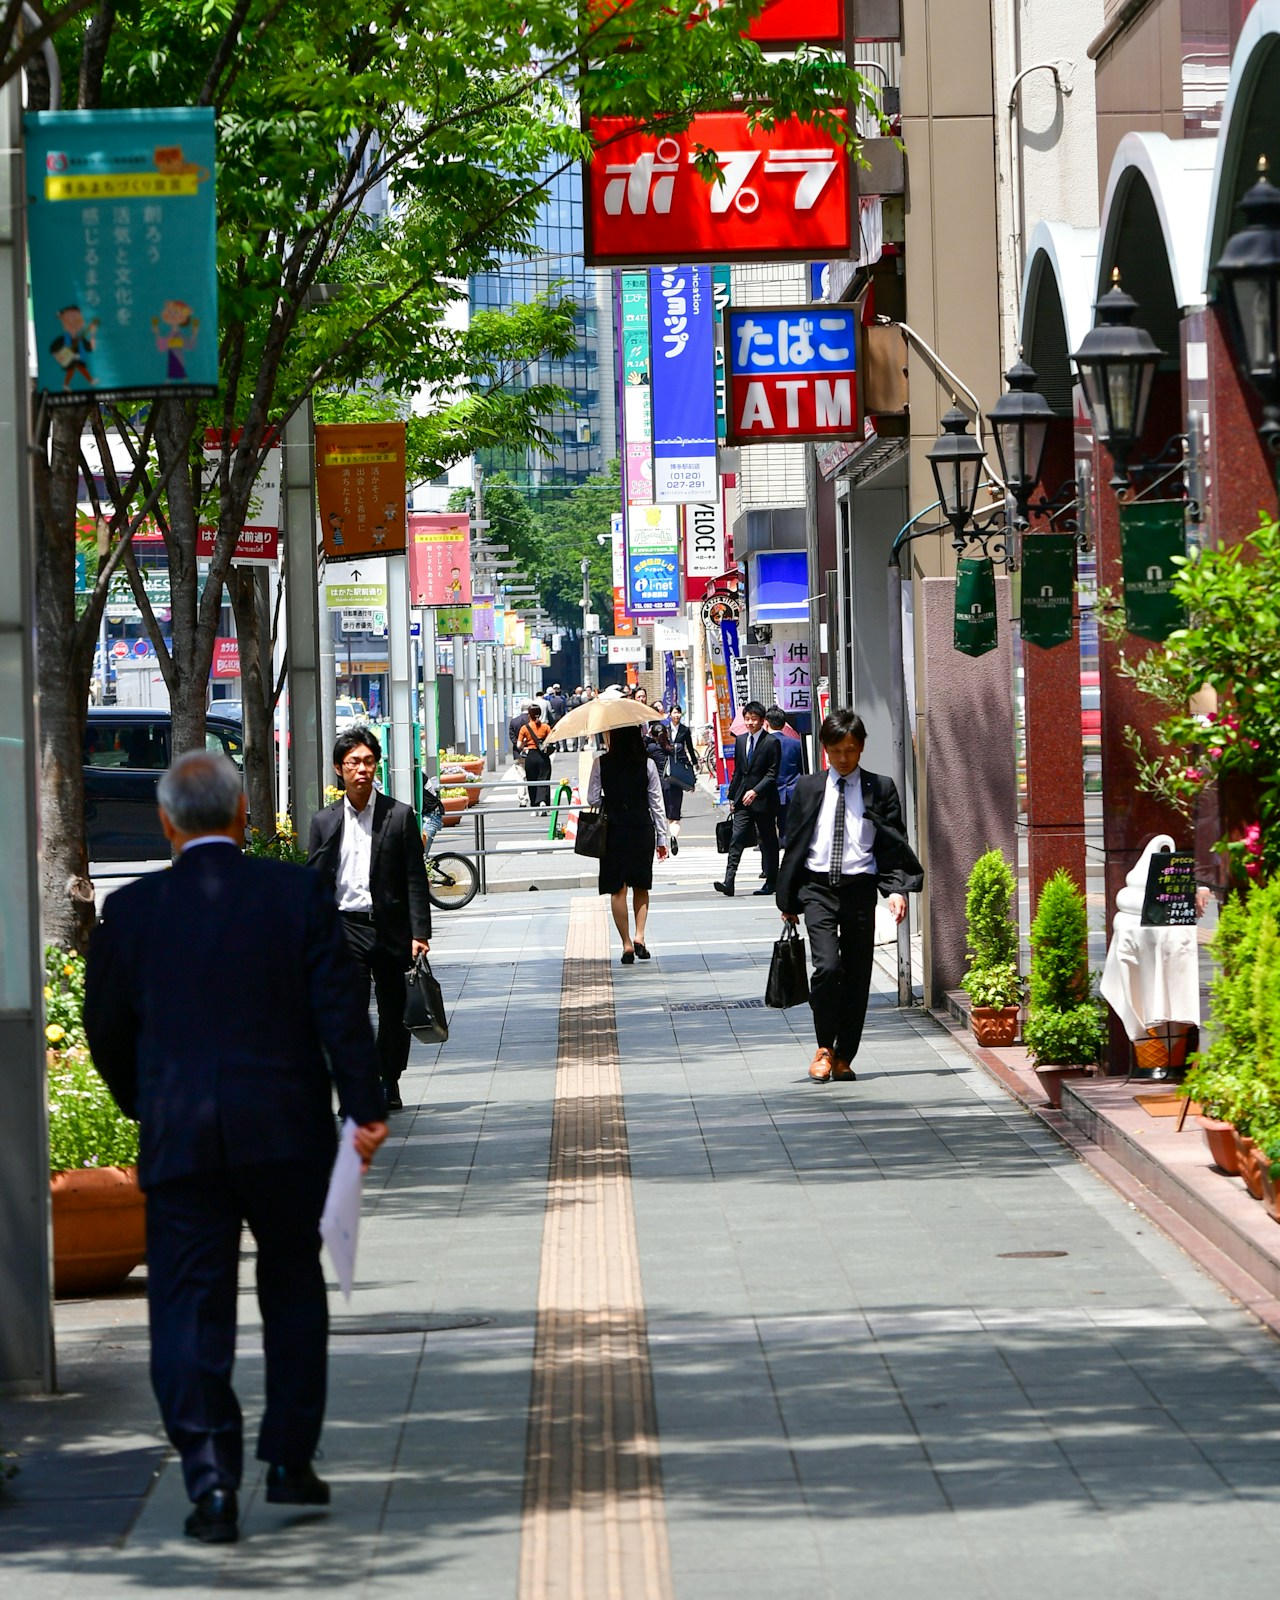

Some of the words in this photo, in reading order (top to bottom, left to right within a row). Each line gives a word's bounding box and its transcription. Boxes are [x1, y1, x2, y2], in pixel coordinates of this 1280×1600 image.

[604, 138, 837, 215] ポプラ
[737, 318, 850, 367] たばこ
[740, 379, 852, 431] ATM
[342, 468, 351, 515] 満ちたまち
[371, 466, 380, 503] 活かそう
[666, 480, 705, 489] 027-291
[670, 472, 701, 480] (0120)
[356, 468, 366, 533] 出会いと希望に
[330, 587, 383, 597] はかた駅前通り
[343, 622, 373, 630] 歩行者優先
[788, 642, 810, 708] 仲介店
